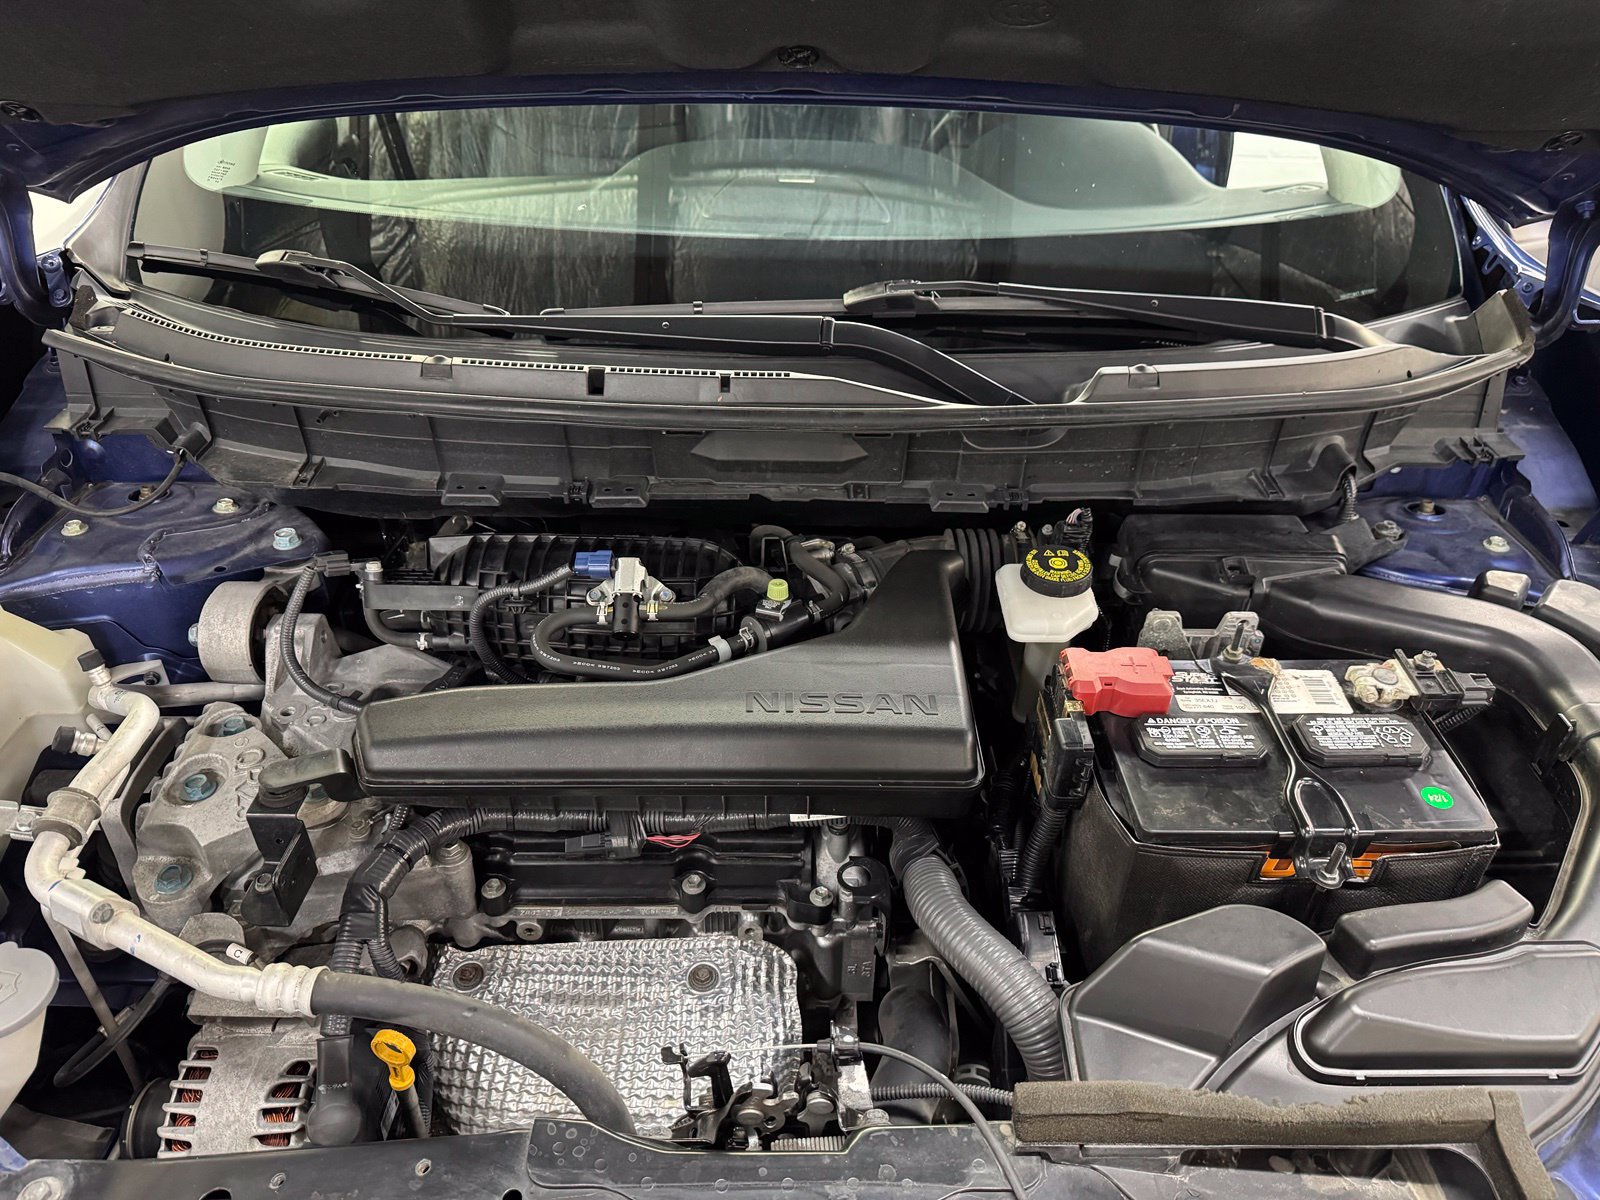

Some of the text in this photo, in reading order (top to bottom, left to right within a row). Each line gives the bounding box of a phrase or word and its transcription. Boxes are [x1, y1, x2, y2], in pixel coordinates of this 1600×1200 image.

[745, 690, 939, 716] NISSAN
[1156, 717, 1196, 725] DANGER
[1203, 717, 1240, 725] POISON
